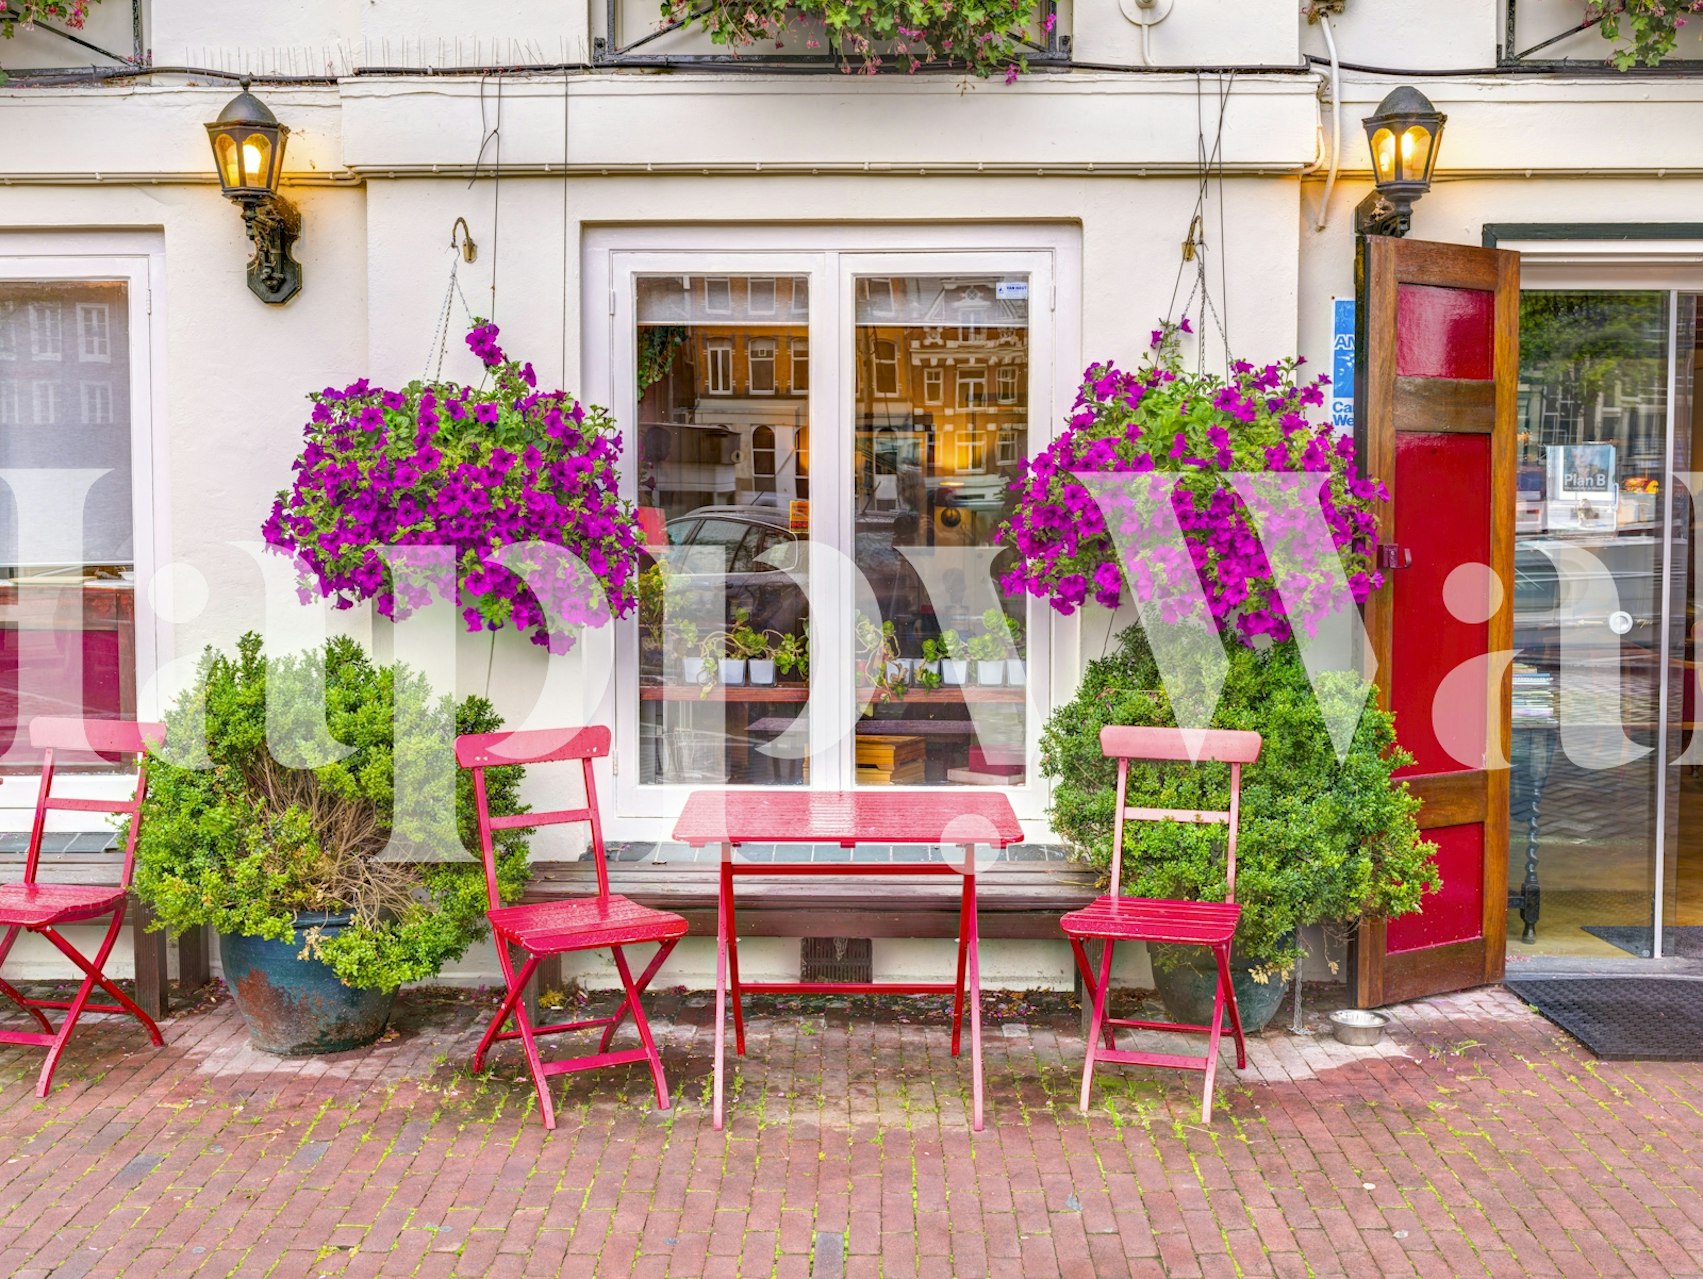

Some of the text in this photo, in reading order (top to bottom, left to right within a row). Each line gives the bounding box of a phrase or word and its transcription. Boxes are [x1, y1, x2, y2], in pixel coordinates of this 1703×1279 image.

[1333, 401, 1355, 413] Ca
[1564, 473, 1606, 486] Plan B
